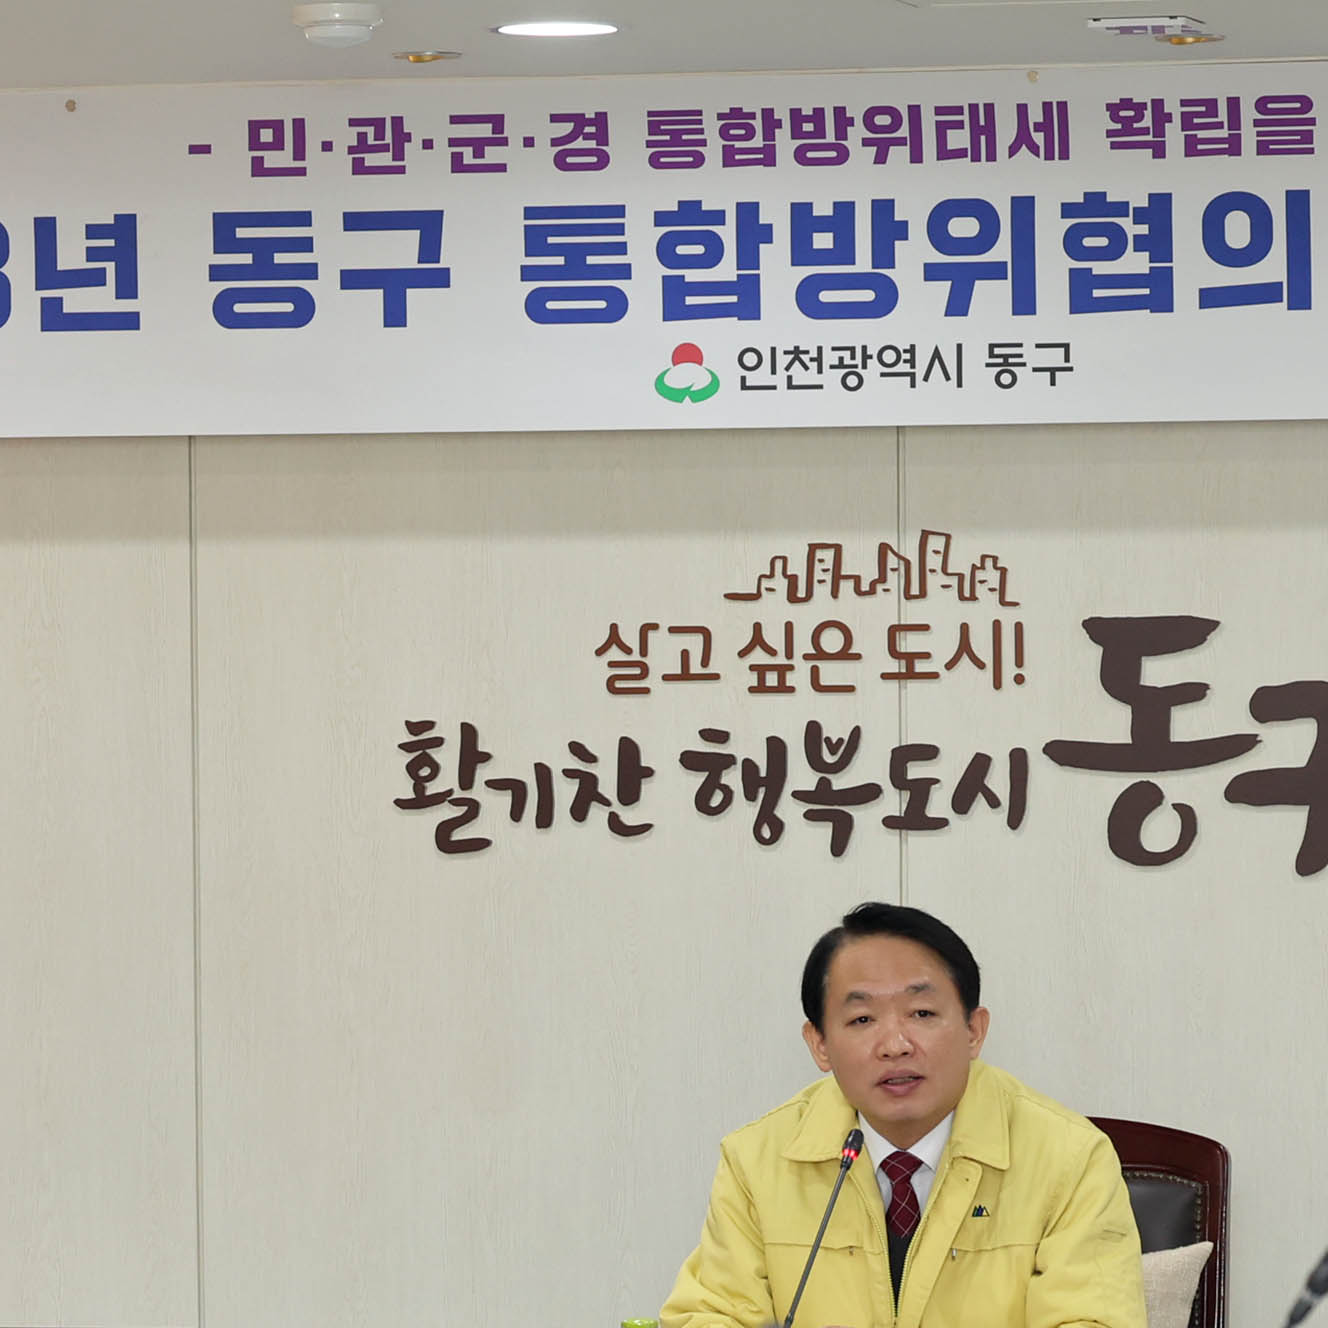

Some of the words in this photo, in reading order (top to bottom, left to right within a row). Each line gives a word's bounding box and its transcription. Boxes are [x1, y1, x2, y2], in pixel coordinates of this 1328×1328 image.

[247, 110, 611, 178] 민·관·군·경
[644, 100, 1070, 171] 통합방위태세
[1104, 93, 1317, 159] 확립을
[208, 209, 451, 330] 동구
[736, 343, 964, 393] 인천광역시
[984, 340, 1075, 390] 동구
[593, 619, 721, 696] 살고
[736, 619, 863, 695] 싶은
[879, 619, 1026, 691] 도시!
[394, 719, 655, 855] 활기찬
[679, 720, 1029, 857] 행복도시
